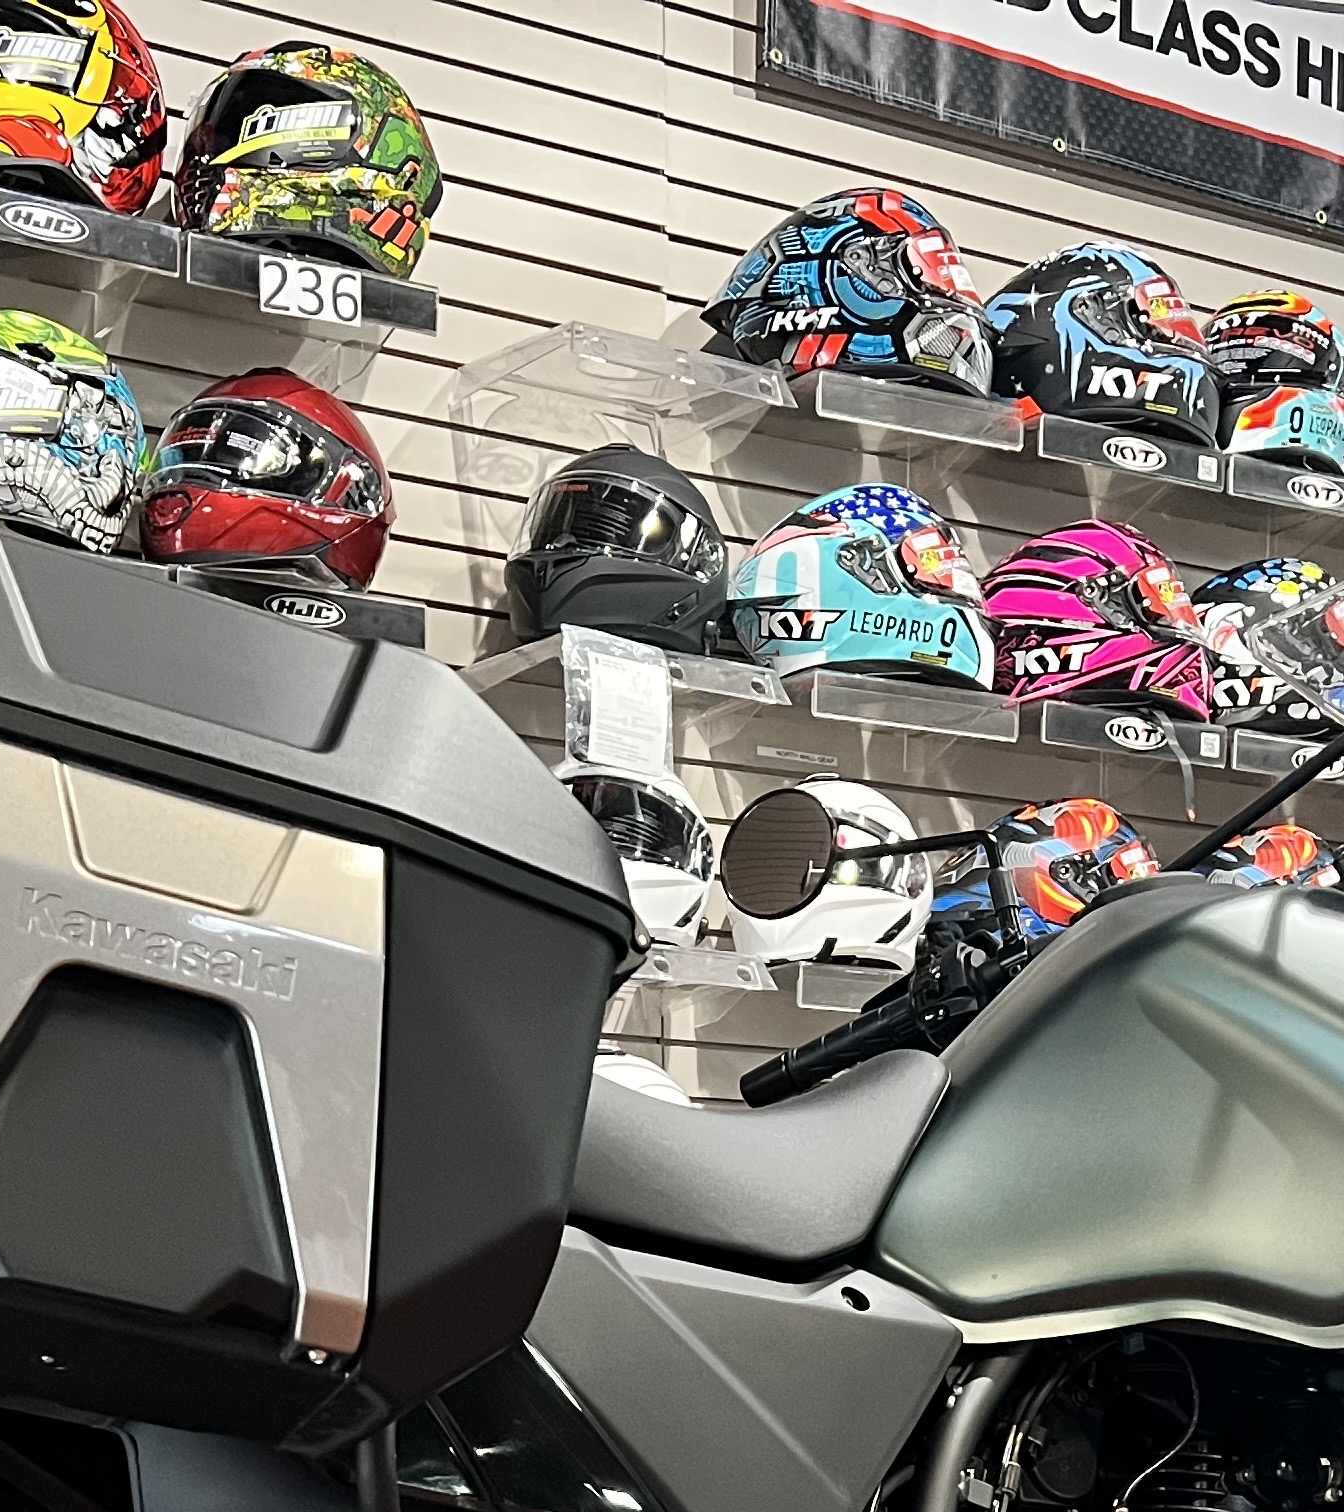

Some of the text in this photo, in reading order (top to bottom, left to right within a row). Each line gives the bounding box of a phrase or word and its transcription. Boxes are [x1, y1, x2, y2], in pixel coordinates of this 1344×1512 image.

[1070, 0, 1281, 88] CLASS
[12, 209, 76, 235] HJC
[262, 260, 359, 322] 236
[771, 306, 840, 332] KYT
[1086, 365, 1174, 402] KYT
[275, 597, 335, 620] HJC
[757, 611, 846, 640] KYT
[850, 610, 934, 643] LEOPARD
[1012, 642, 1099, 676] KYT
[17, 886, 299, 1001] Kawasaki
